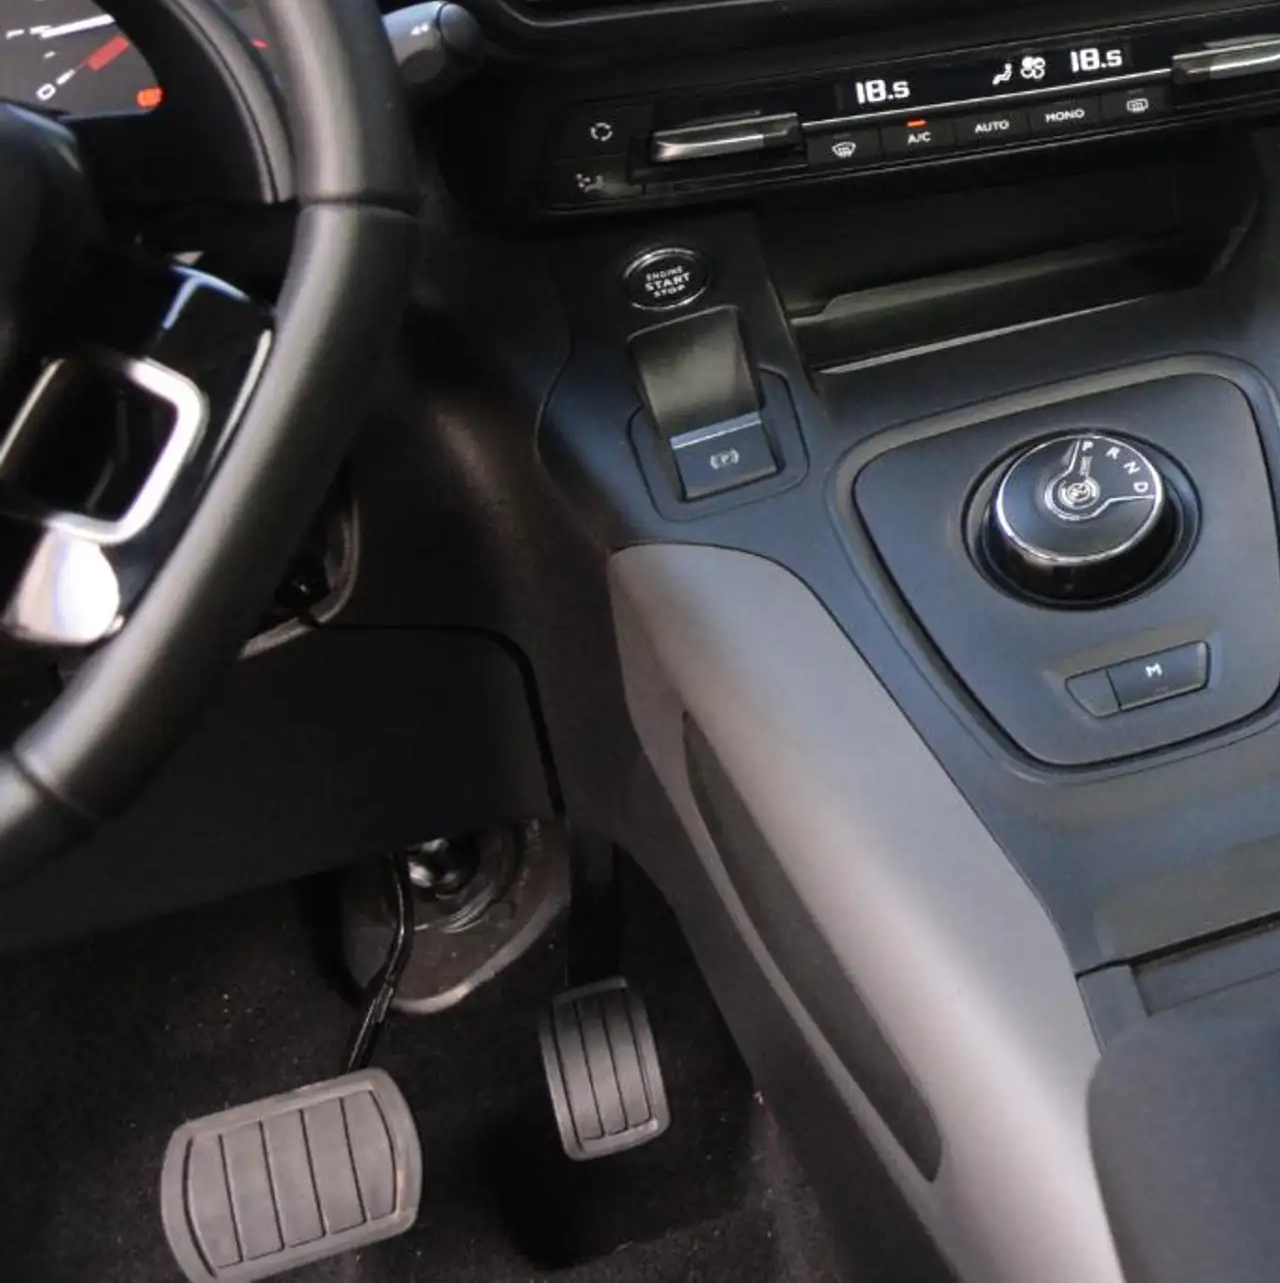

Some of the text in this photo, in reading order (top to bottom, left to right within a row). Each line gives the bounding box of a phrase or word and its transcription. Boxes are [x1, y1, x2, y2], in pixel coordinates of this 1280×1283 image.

[36, 83, 56, 101] 0
[1045, 108, 1085, 124] MONO
[974, 119, 1010, 135] AUTO
[907, 130, 932, 145] A/C
[645, 271, 691, 292] START
[1082, 440, 1149, 493] P R N D
[1145, 662, 1162, 678] M
